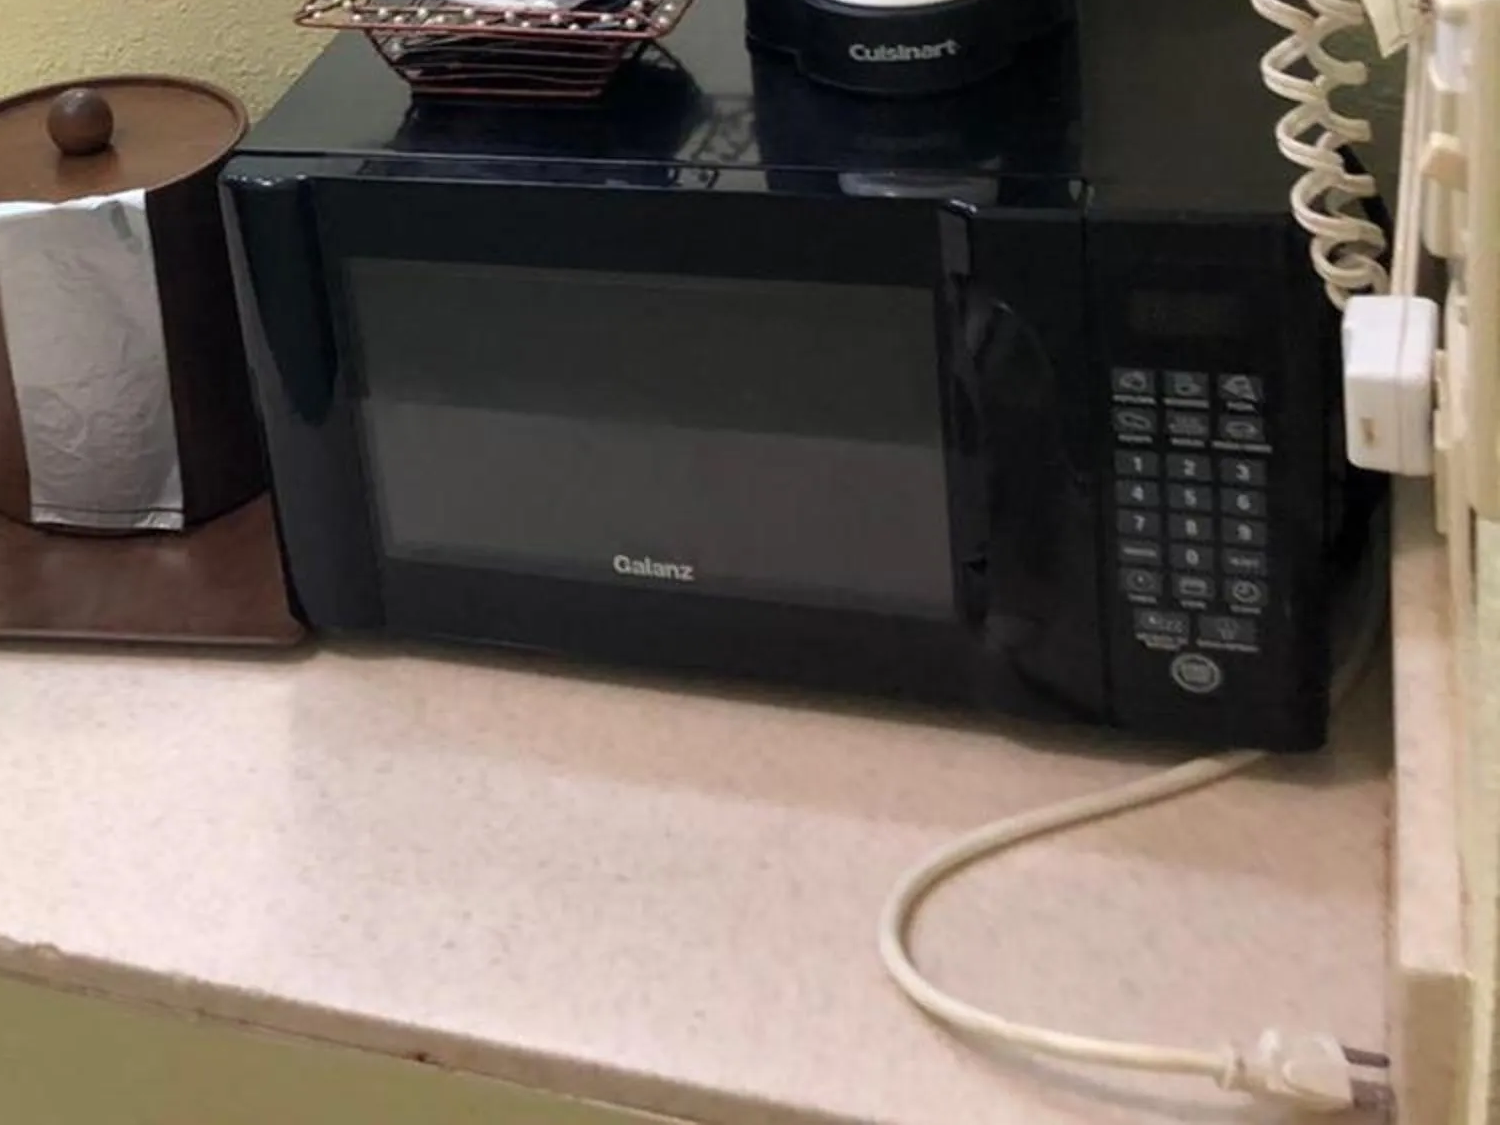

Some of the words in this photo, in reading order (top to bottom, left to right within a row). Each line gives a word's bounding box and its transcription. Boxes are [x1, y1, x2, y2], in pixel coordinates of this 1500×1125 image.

[848, 39, 957, 62] Cuisinart
[1133, 456, 1142, 472] 1
[1184, 458, 1196, 475] 2
[1236, 463, 1250, 481] 3
[1131, 486, 1144, 502] 4
[1184, 488, 1197, 507] 5
[1236, 494, 1250, 510] 6
[1133, 515, 1145, 531] 7
[1185, 519, 1198, 536] 8
[1185, 548, 1199, 565] 0
[613, 555, 695, 582] Galanz
